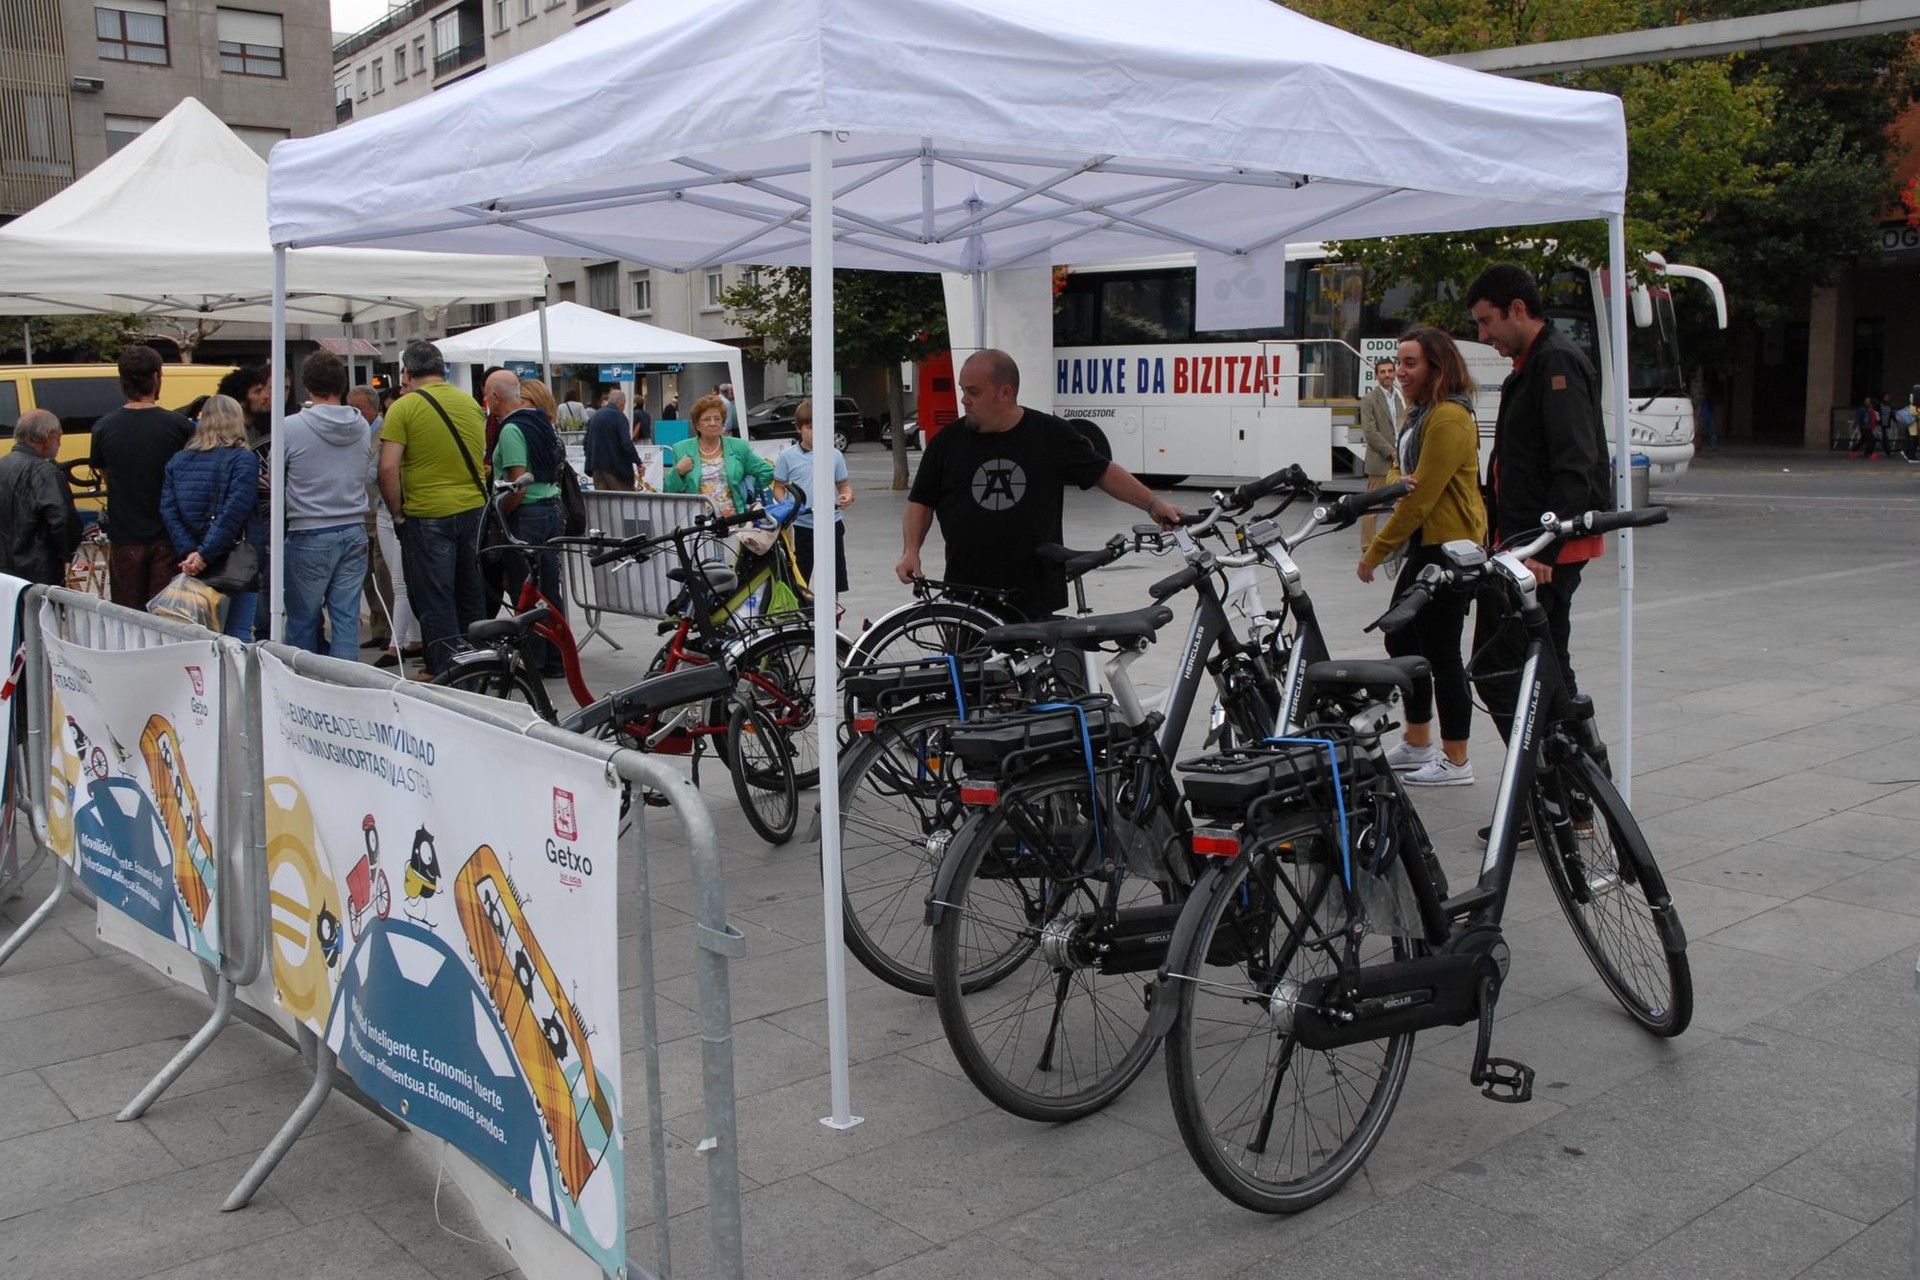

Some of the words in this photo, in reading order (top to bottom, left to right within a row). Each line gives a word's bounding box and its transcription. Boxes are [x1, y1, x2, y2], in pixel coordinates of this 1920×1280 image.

[1057, 358, 1126, 395] HAUXE
[1137, 357, 1166, 395] DA
[1173, 355, 1281, 398] BIZITZA!
[1063, 408, 1116, 419] BRIDGESTONE
[1184, 625, 1205, 680] HERCULES
[1289, 658, 1307, 722] HERCULES
[1523, 680, 1541, 751] HERCULES
[545, 838, 593, 876] Getxo
[367, 1019, 420, 1064] inteligente.
[473, 1073, 505, 1113] fuerte.
[475, 1110, 508, 1145] sendoa.
